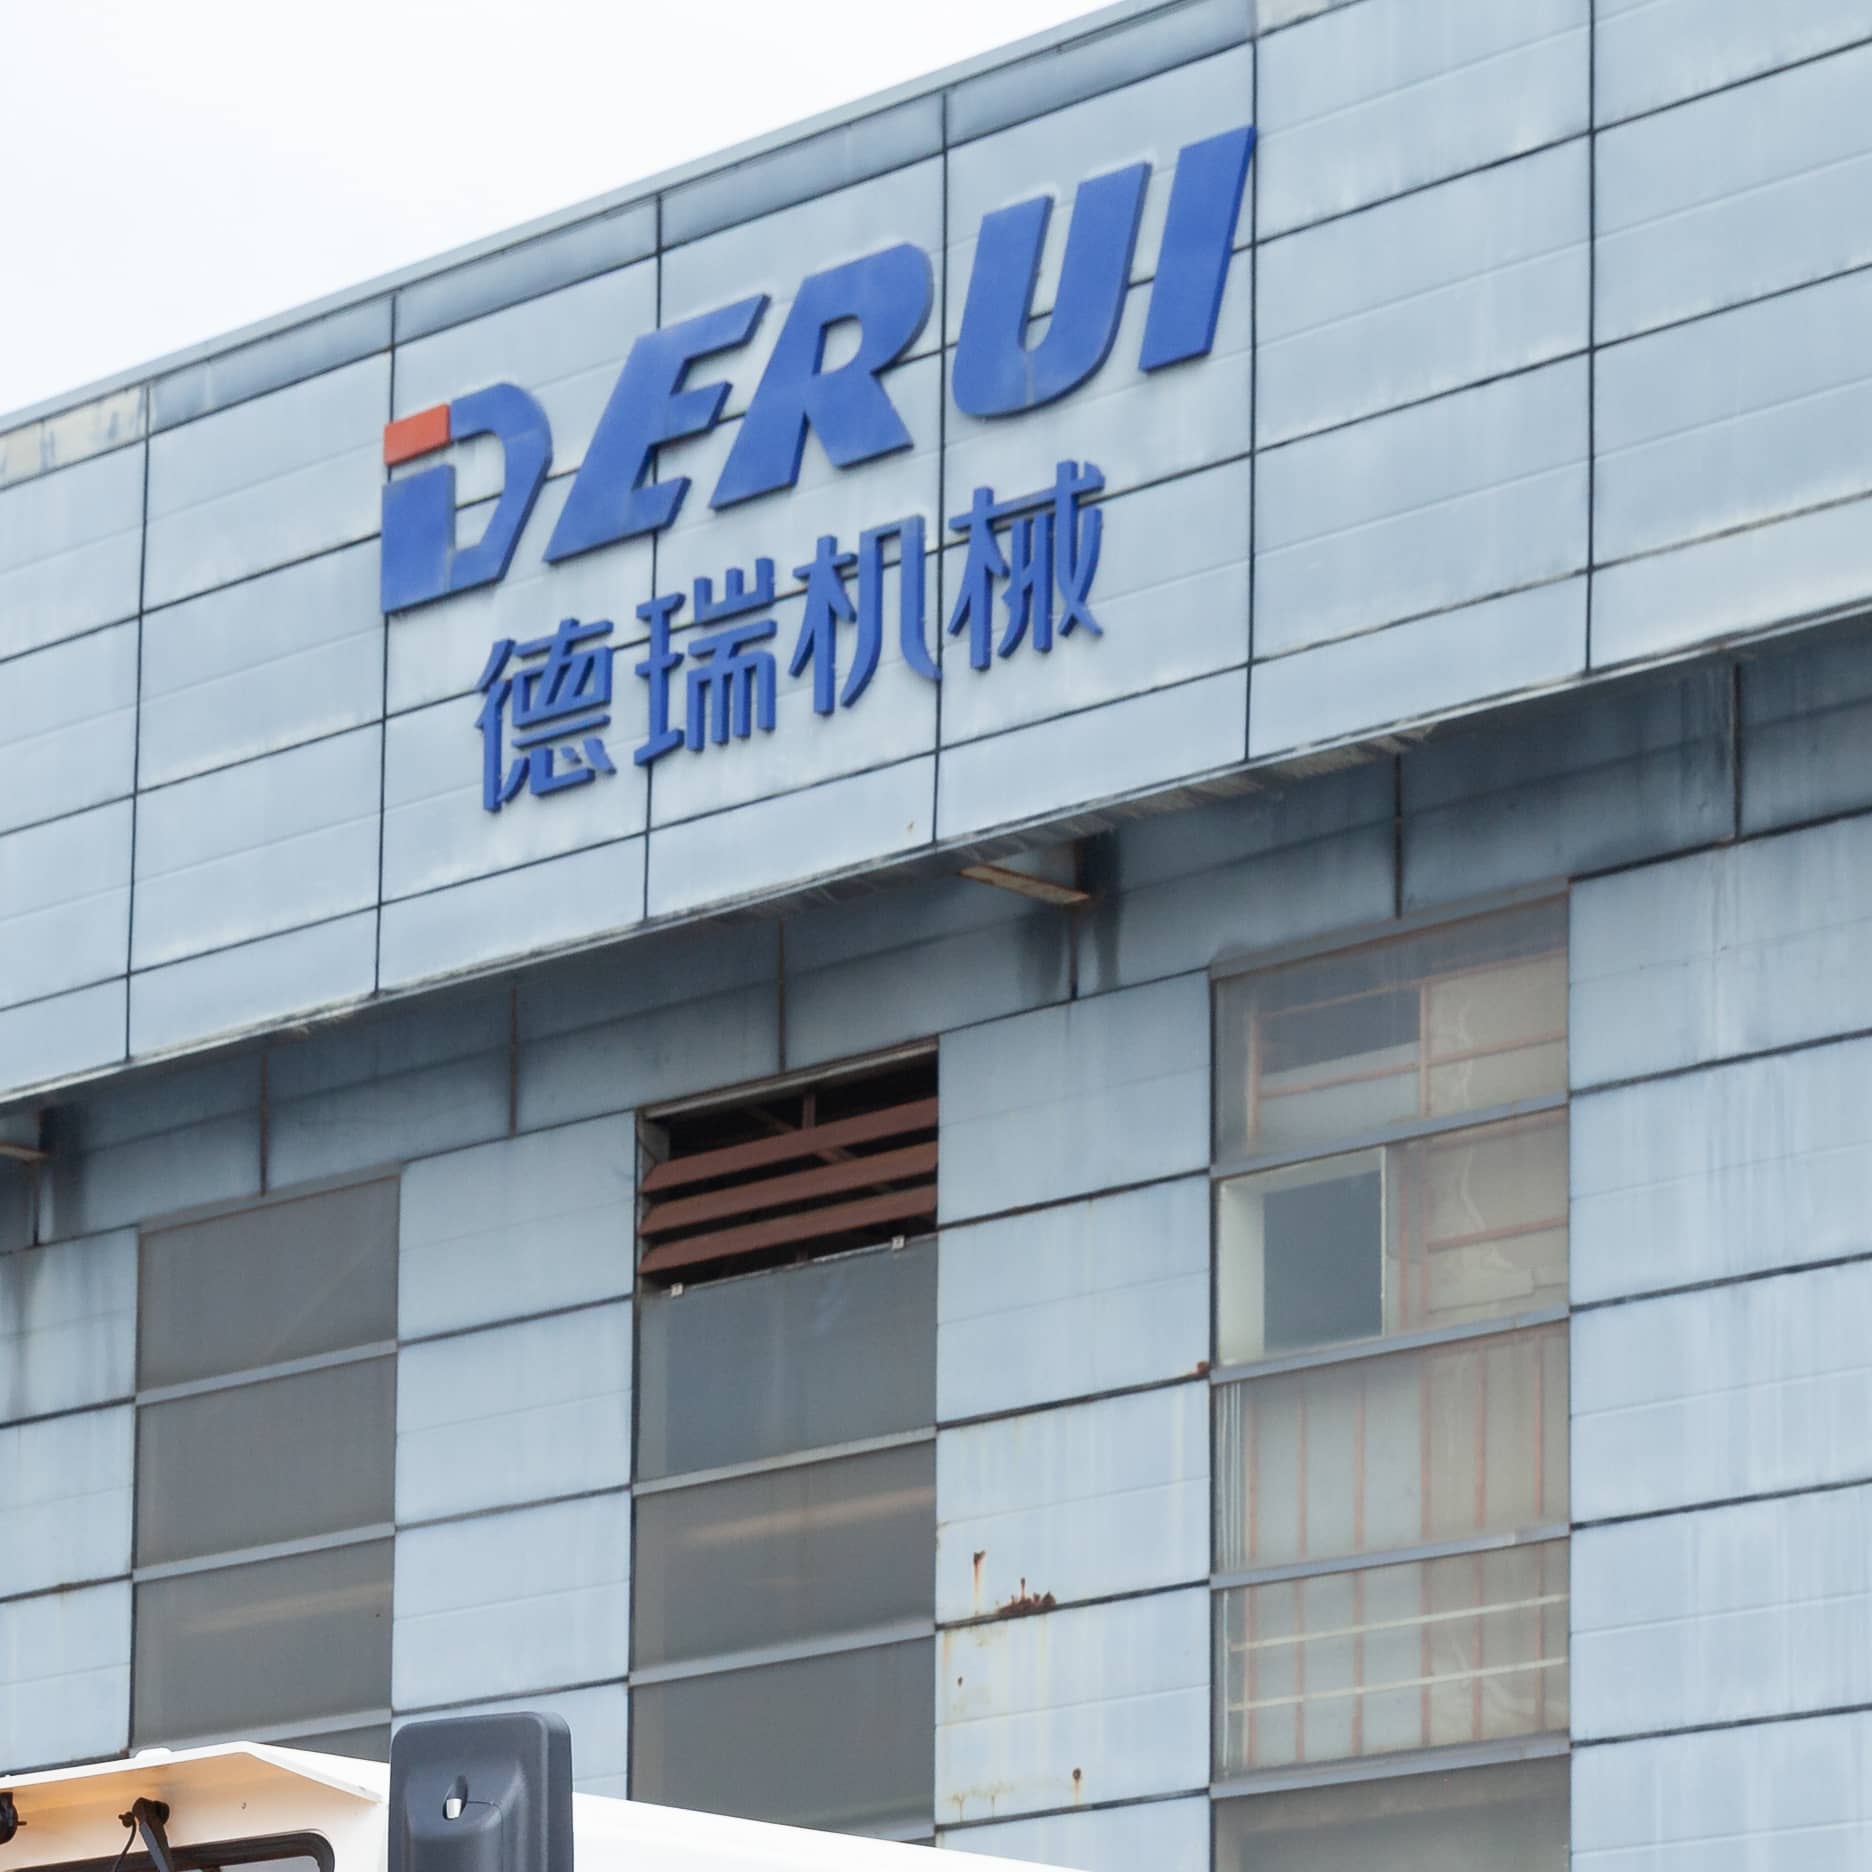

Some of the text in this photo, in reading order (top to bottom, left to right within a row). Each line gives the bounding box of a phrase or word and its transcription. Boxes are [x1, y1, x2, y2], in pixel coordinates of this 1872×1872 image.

[381, 124, 1258, 613] DERUI
[476, 459, 1105, 812] 德瑞机械
